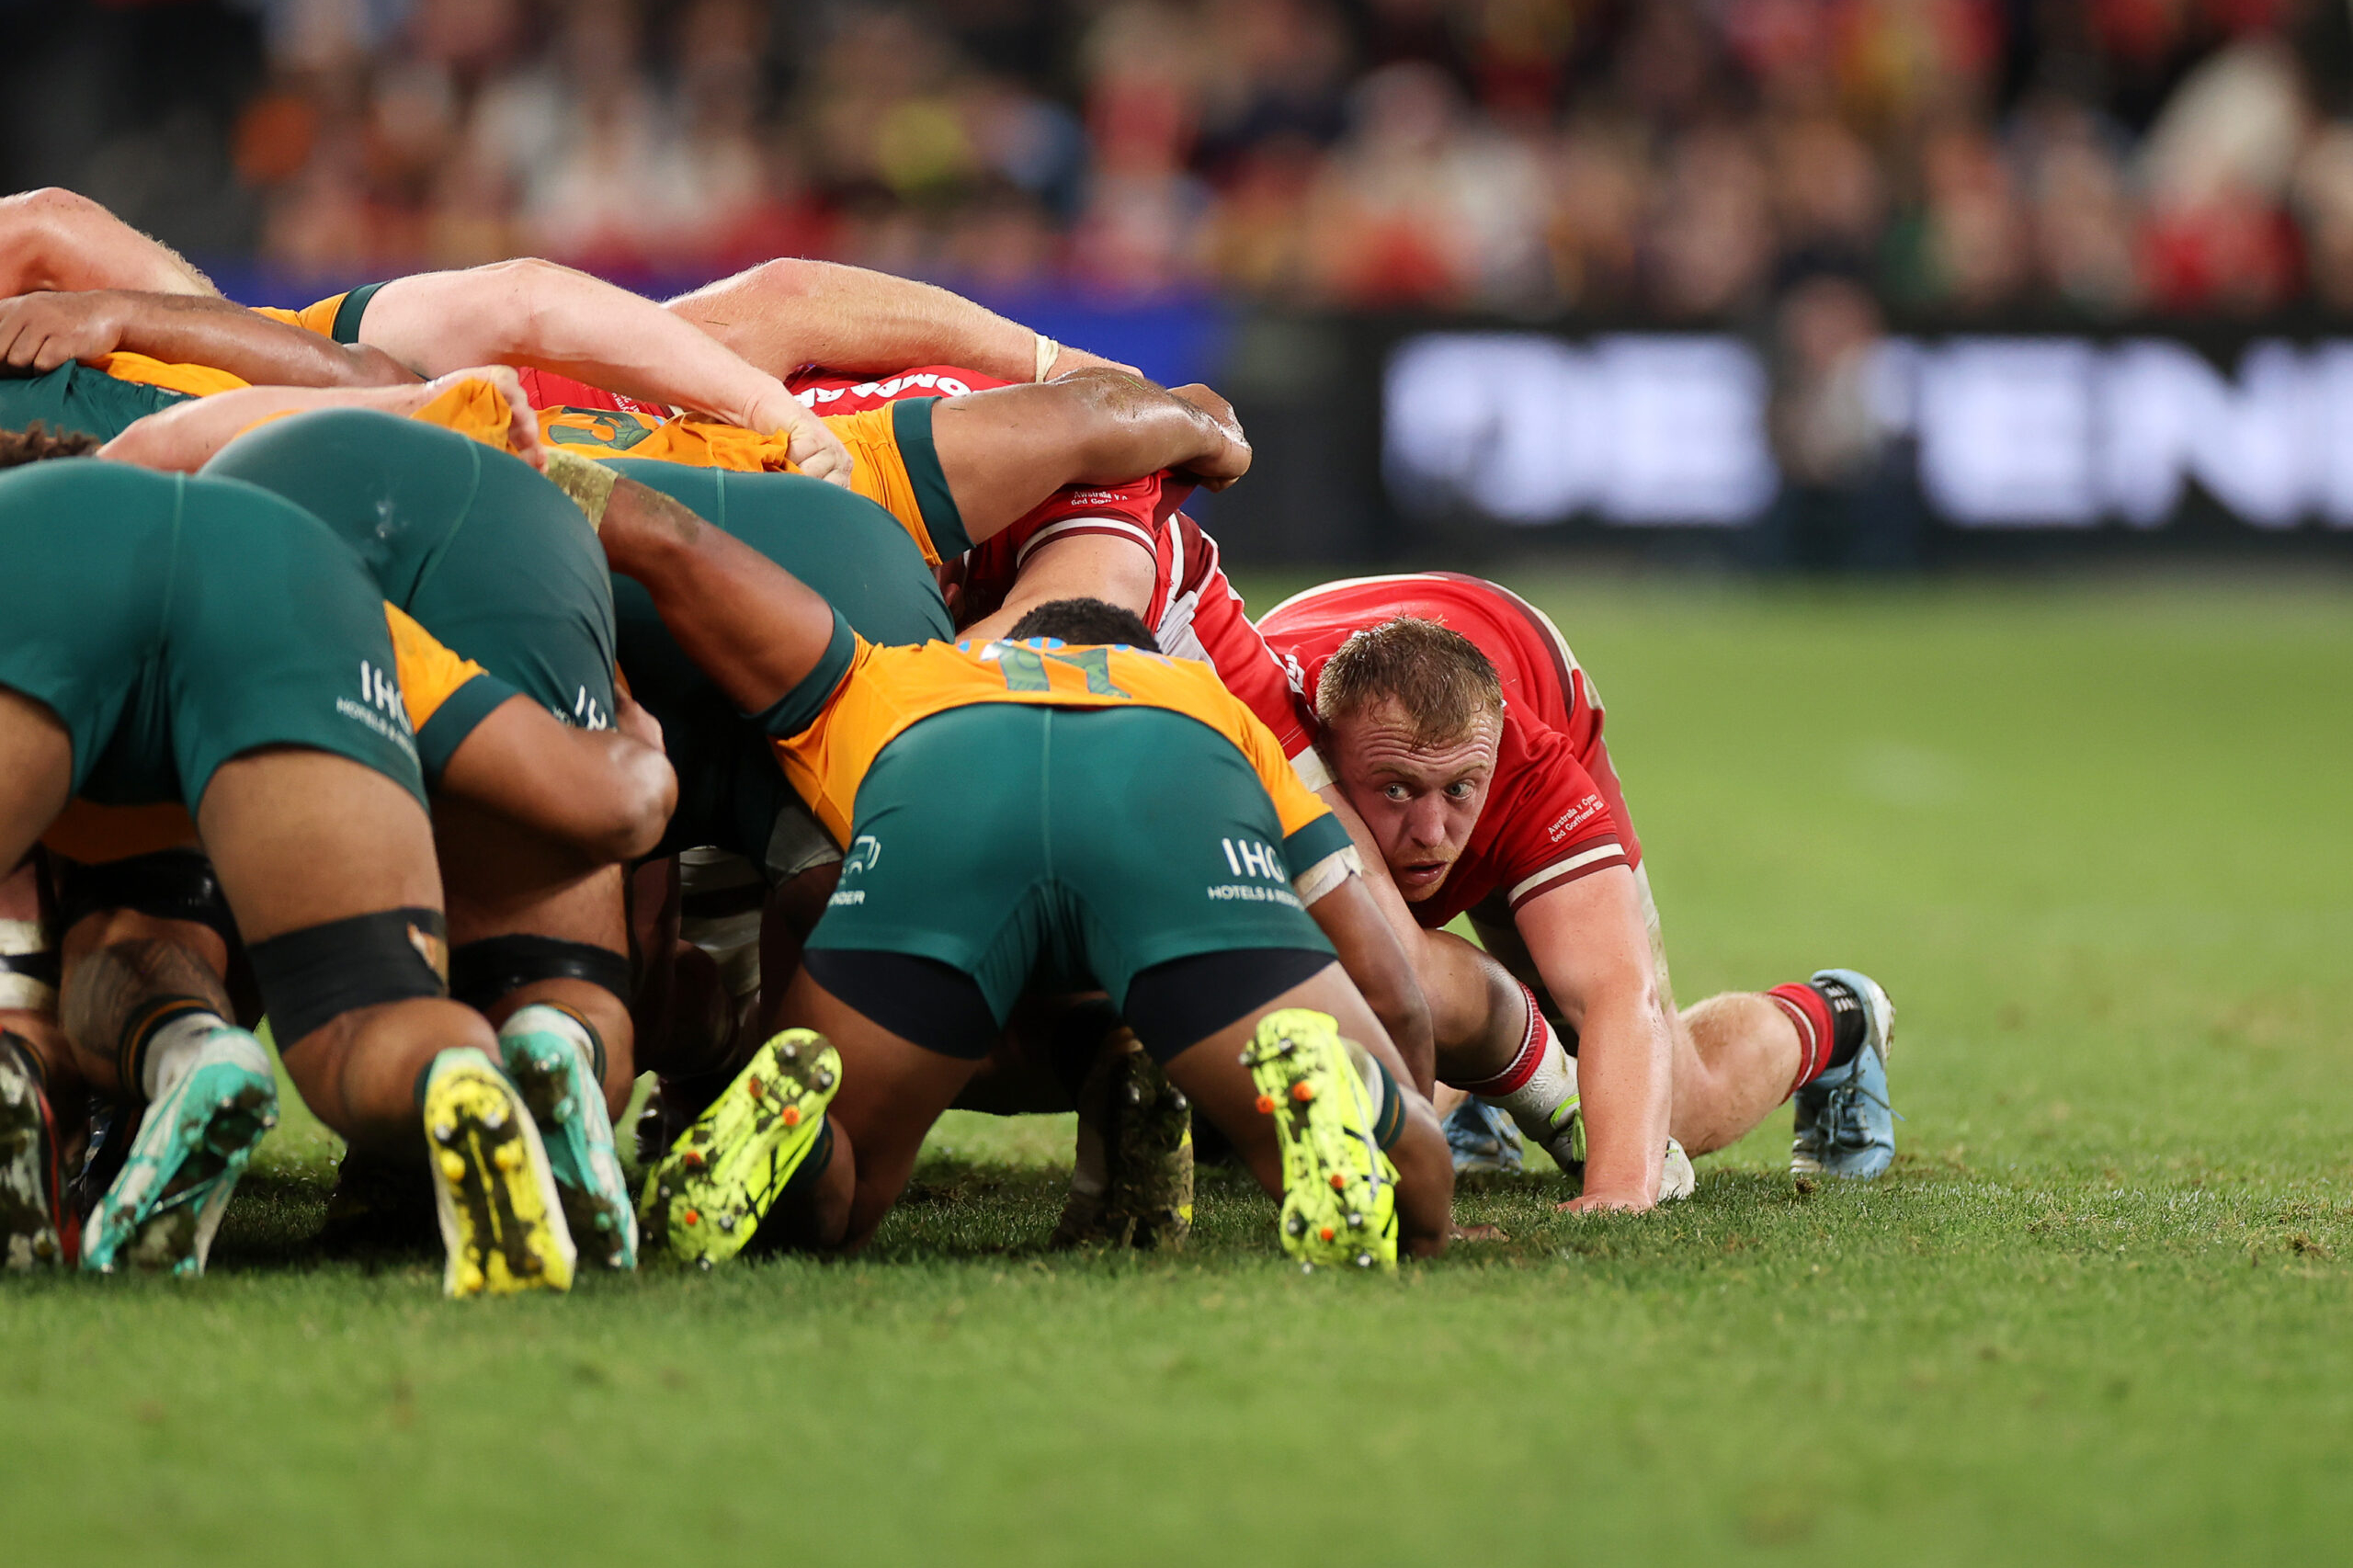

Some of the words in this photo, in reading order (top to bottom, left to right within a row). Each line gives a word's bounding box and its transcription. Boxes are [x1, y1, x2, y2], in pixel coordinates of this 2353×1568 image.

[1548, 808, 1578, 835] Awstralia
[1551, 829, 1567, 843] 6ed
[1206, 884, 1266, 901] HOTELS
